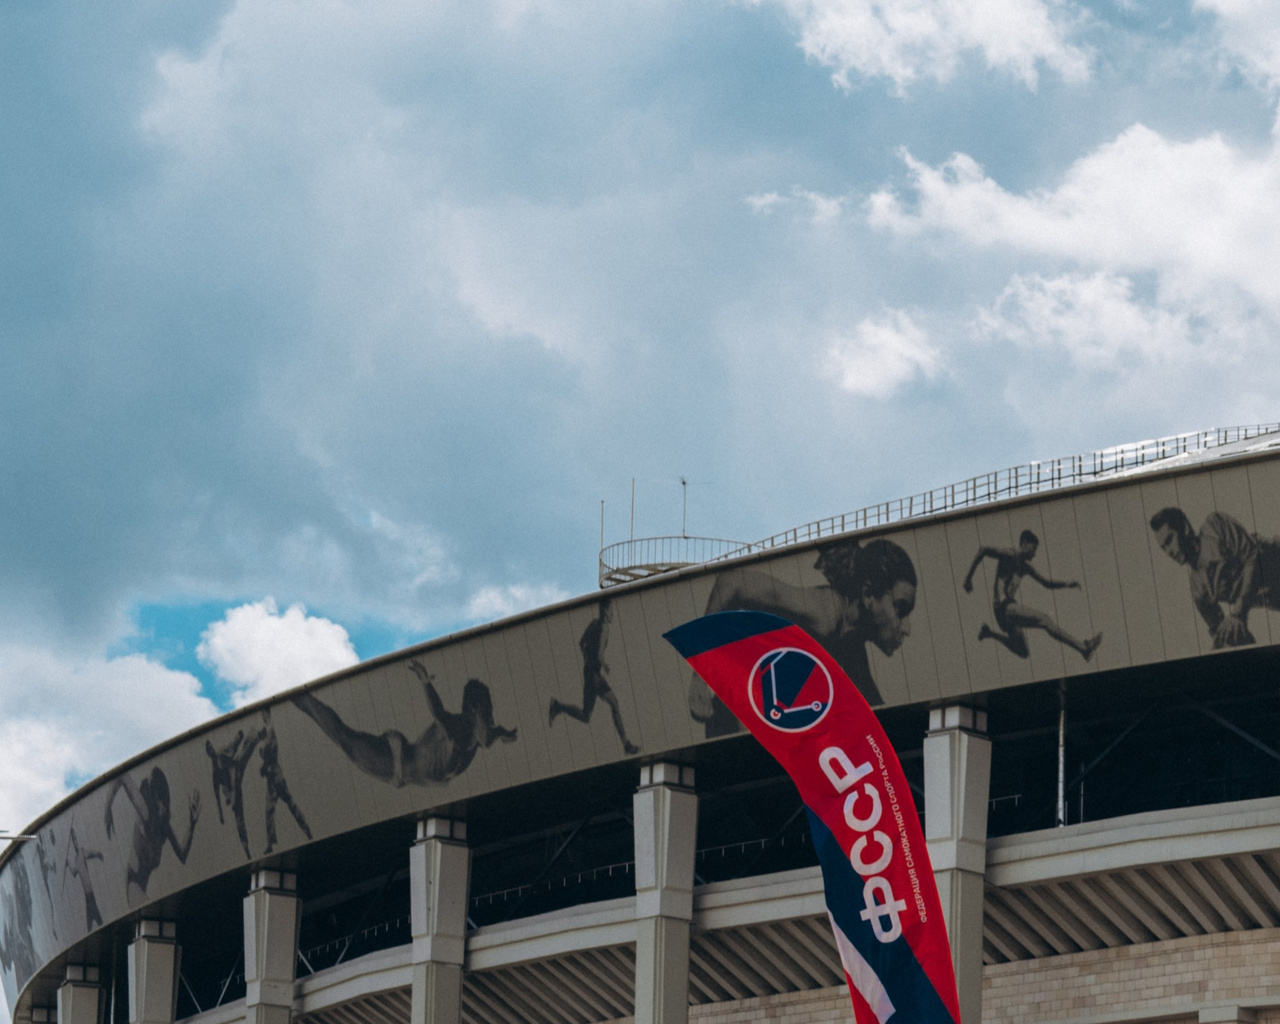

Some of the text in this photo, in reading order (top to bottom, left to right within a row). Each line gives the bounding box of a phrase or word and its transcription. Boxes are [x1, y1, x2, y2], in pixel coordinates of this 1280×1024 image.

[819, 746, 907, 943] ФССР
[866, 734, 928, 923] ФЕДЕРАЦИЯ САМОКАТНОГО СПОРТА РОССИИ
